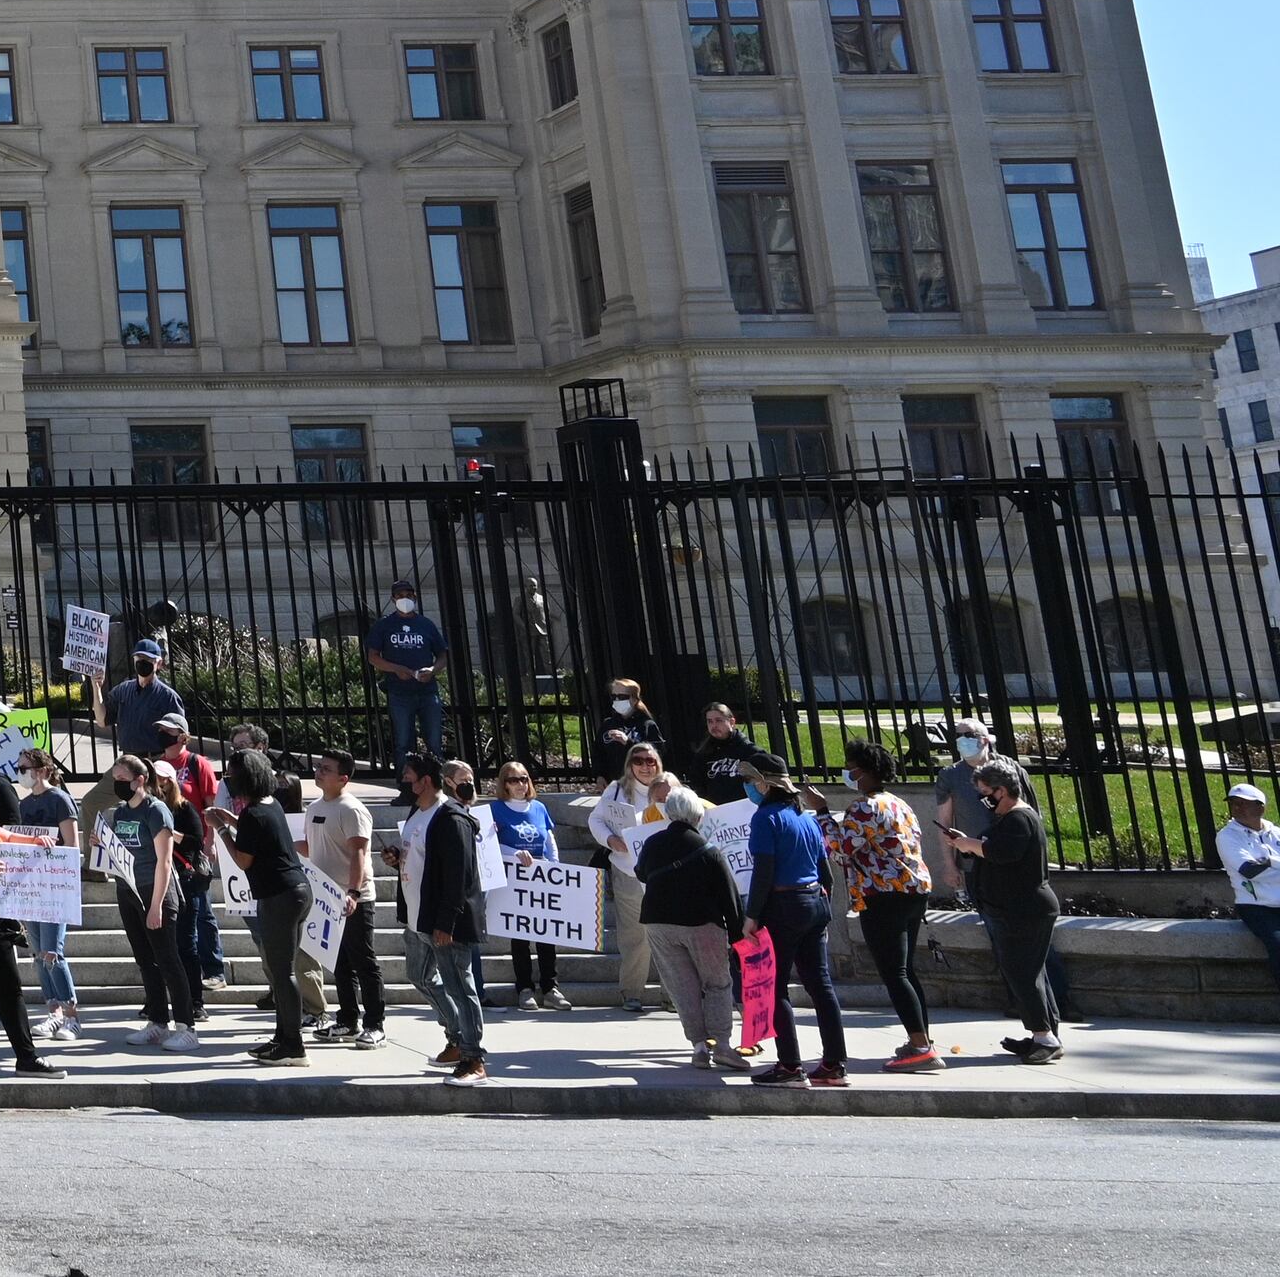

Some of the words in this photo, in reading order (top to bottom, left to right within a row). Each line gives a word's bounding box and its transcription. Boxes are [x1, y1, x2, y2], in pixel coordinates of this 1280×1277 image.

[72, 613, 103, 633] BLACK
[390, 634, 424, 645] GLAHR
[65, 643, 105, 664] AMERICAN
[715, 823, 752, 842] HARVE
[33, 850, 41, 858] is
[44, 847, 67, 860] Power
[728, 849, 755, 869] PEA
[5, 863, 33, 873] formation
[503, 861, 581, 888] TEACH
[514, 888, 561, 911] THE
[500, 912, 582, 941] TRUTH
